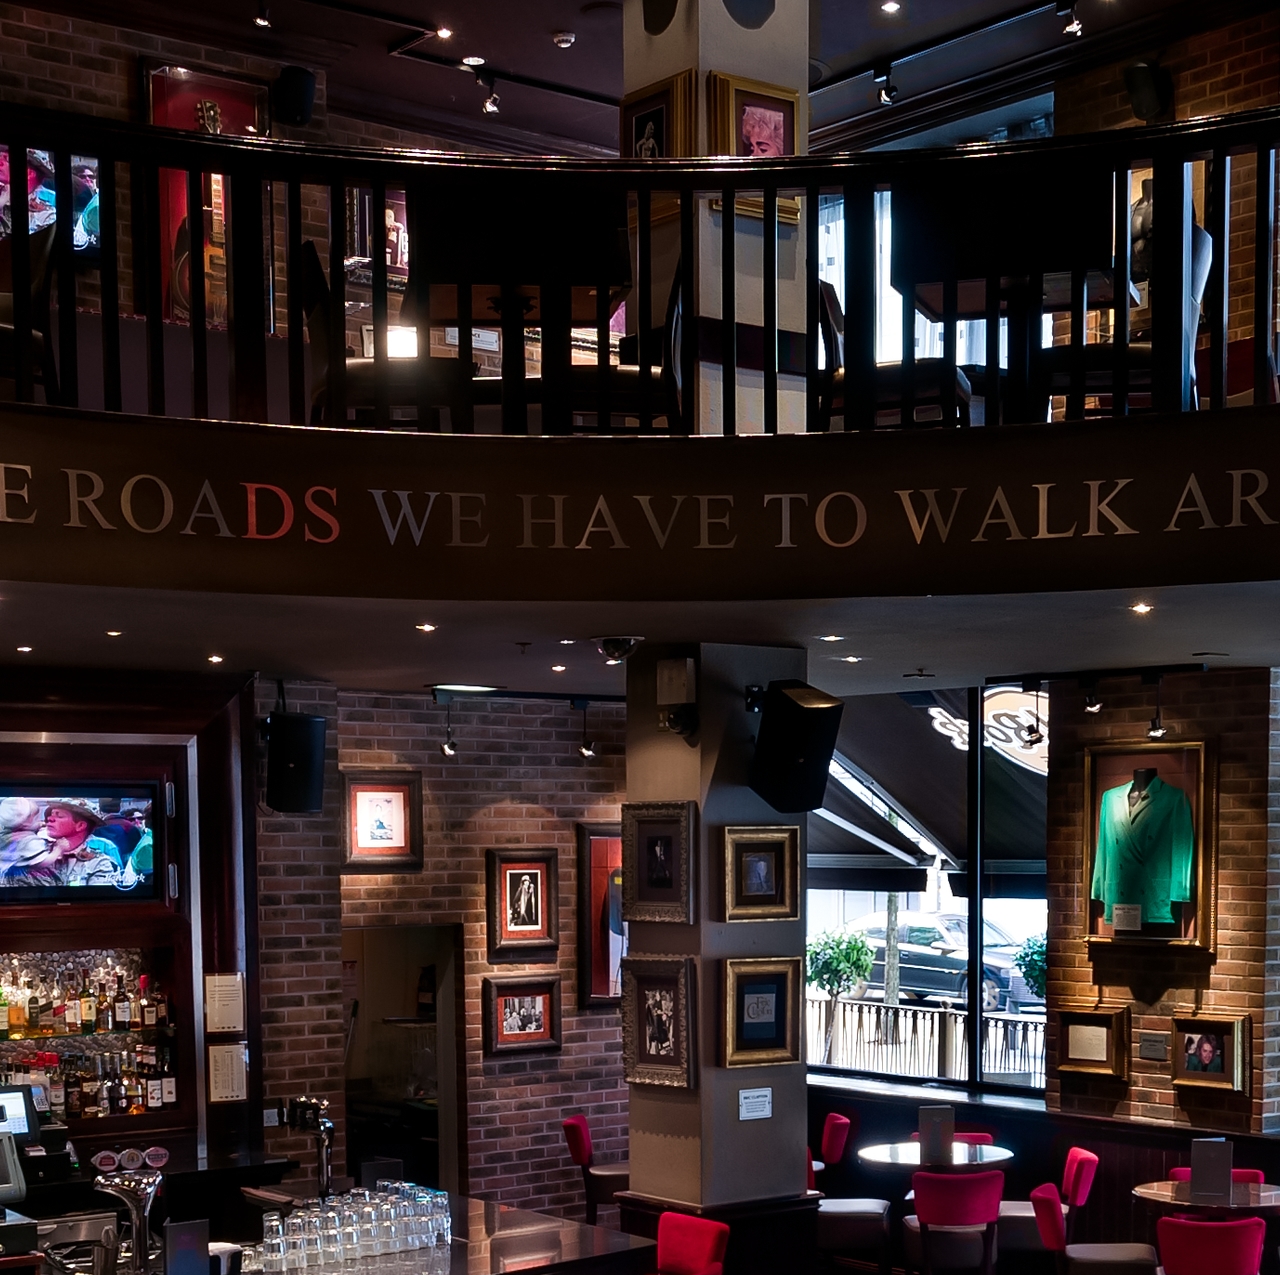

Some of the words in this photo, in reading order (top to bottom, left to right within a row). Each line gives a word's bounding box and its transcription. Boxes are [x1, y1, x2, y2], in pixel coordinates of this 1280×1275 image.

[60, 467, 343, 545] ROADS
[367, 488, 491, 549] WE
[515, 492, 739, 550] HAVE
[764, 489, 870, 550] TO
[894, 478, 1141, 546] WALK
